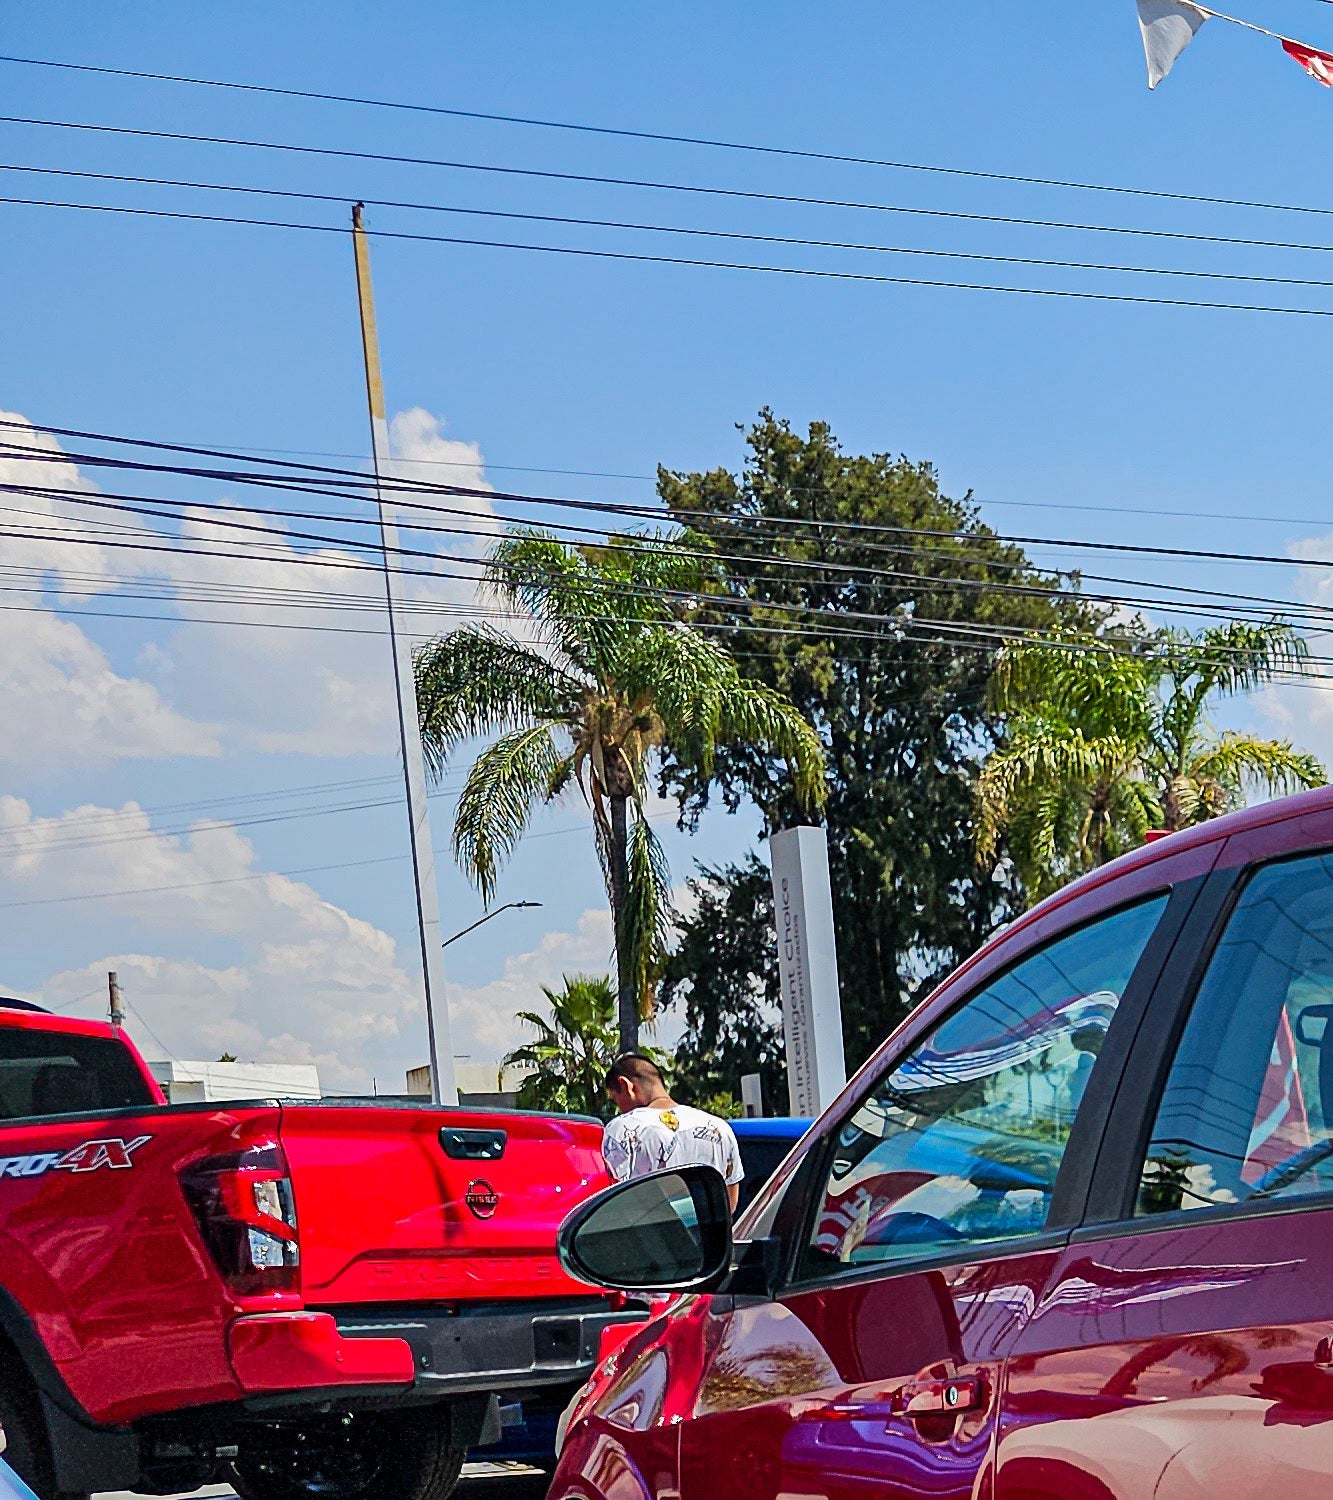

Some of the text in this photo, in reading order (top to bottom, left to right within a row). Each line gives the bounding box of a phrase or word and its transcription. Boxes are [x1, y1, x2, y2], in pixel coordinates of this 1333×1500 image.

[781, 877, 794, 961] Choice
[788, 968, 804, 1087] Intelligent
[0, 1135, 153, 1178] RO-4X
[366, 1258, 562, 1283] FRONTIE
